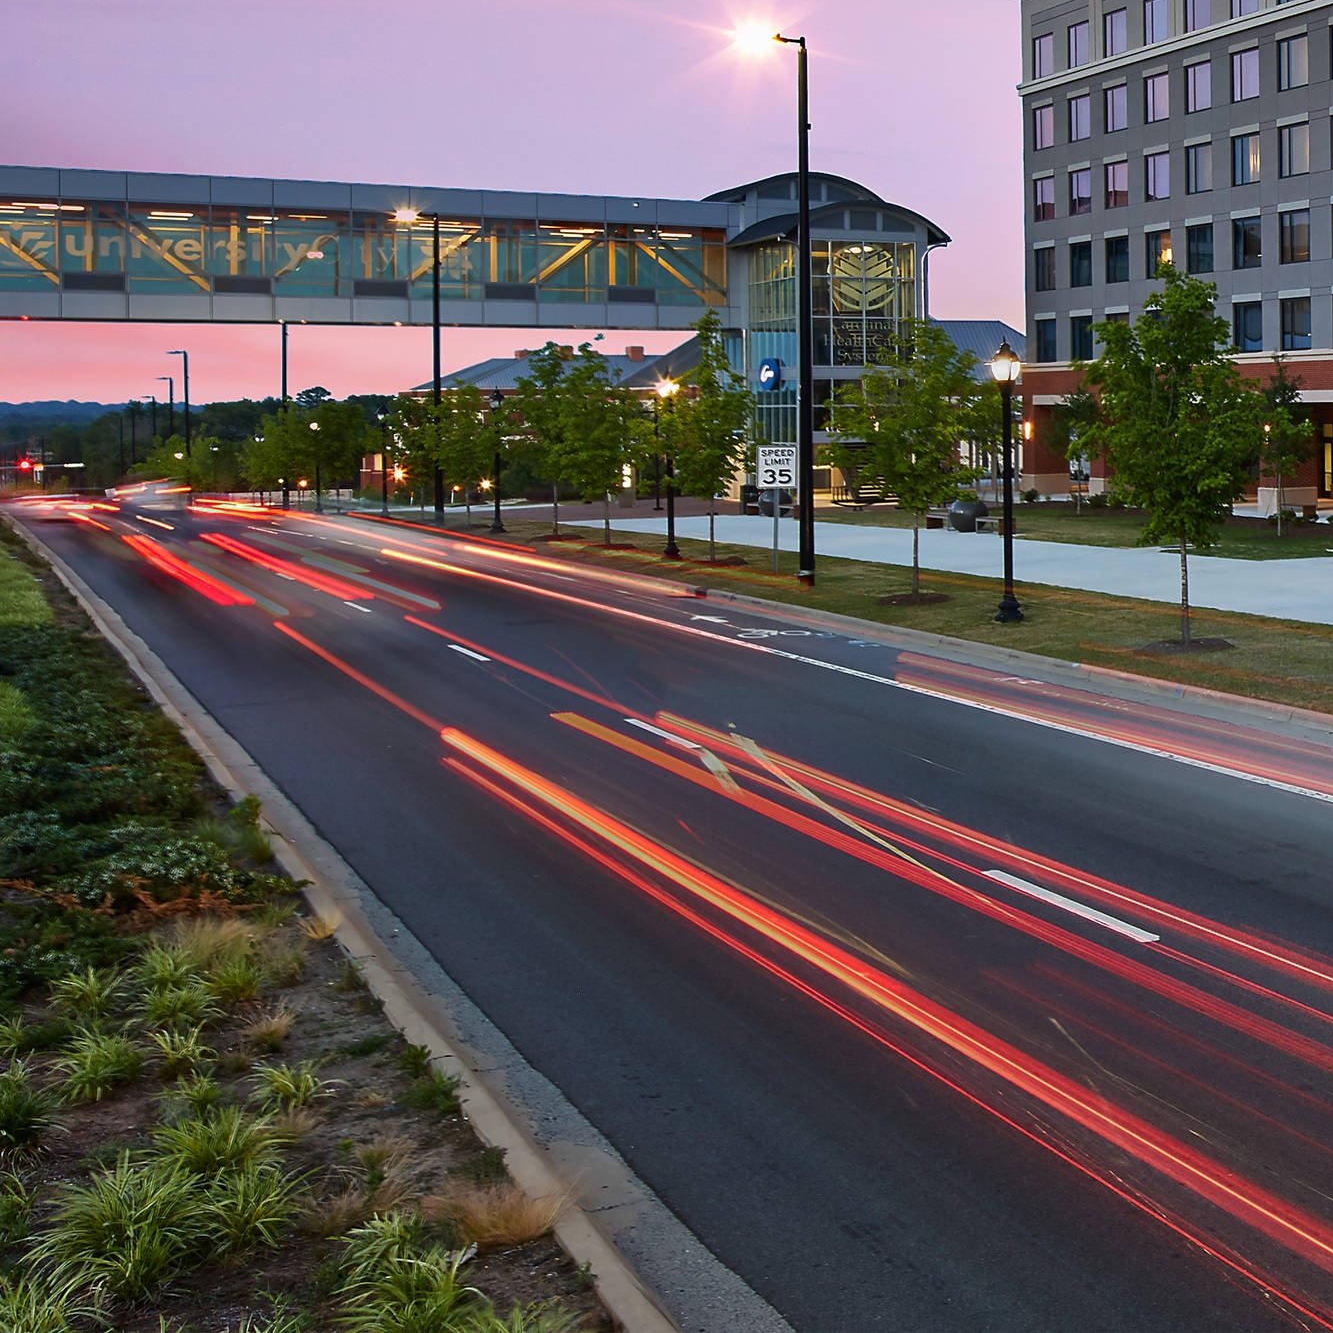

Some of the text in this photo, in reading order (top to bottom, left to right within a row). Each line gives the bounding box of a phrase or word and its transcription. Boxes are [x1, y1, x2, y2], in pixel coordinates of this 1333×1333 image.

[833, 319, 898, 331] Carolina
[823, 333, 905, 346] HealthCa
[761, 449, 794, 457] SPEED
[764, 458, 791, 466] LIMIT
[762, 469, 792, 484] 35
